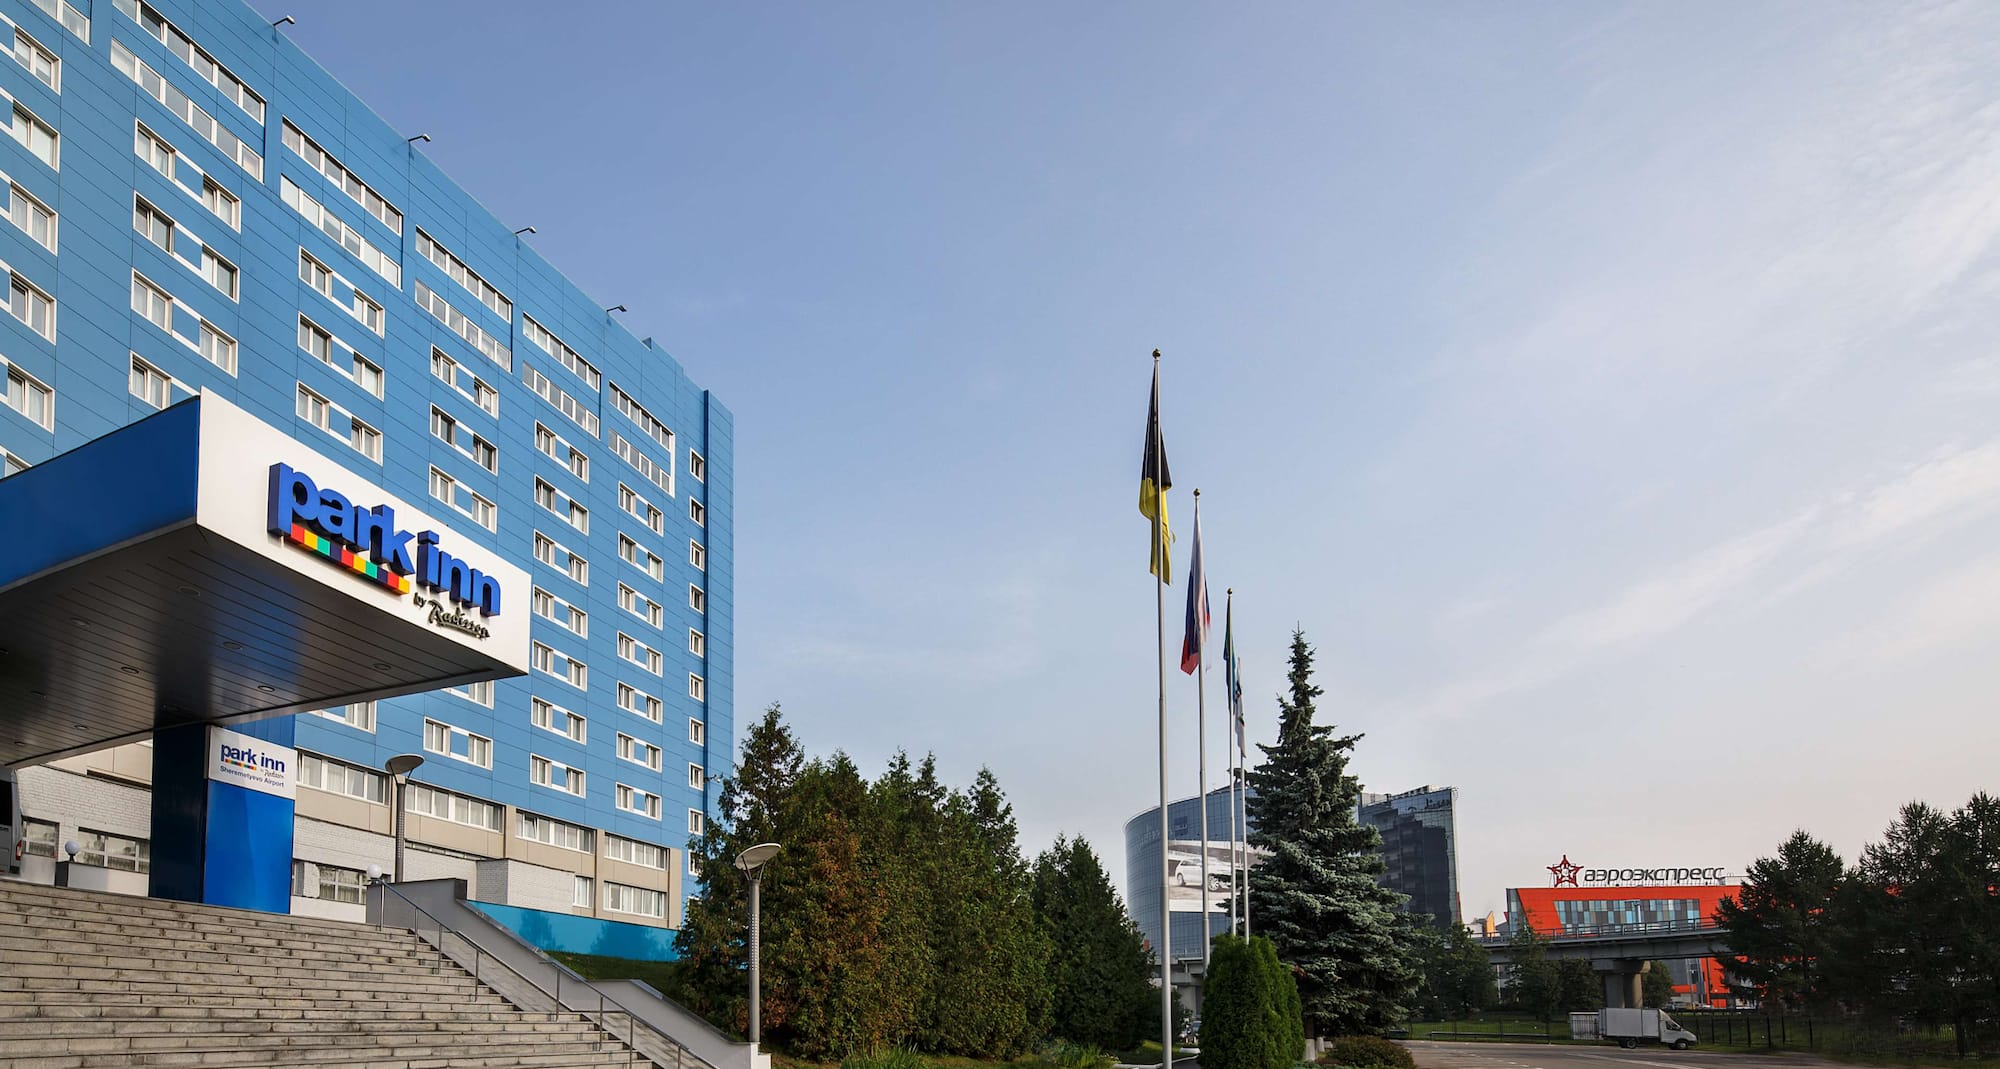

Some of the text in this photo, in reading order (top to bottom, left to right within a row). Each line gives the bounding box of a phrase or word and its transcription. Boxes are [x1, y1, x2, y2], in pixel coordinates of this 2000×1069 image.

[267, 462, 500, 617] park inn
[413, 592, 426, 608] by
[221, 744, 285, 773] park inn
[264, 777, 285, 788] Airport
[1584, 867, 1725, 884] аэроэкспресс
